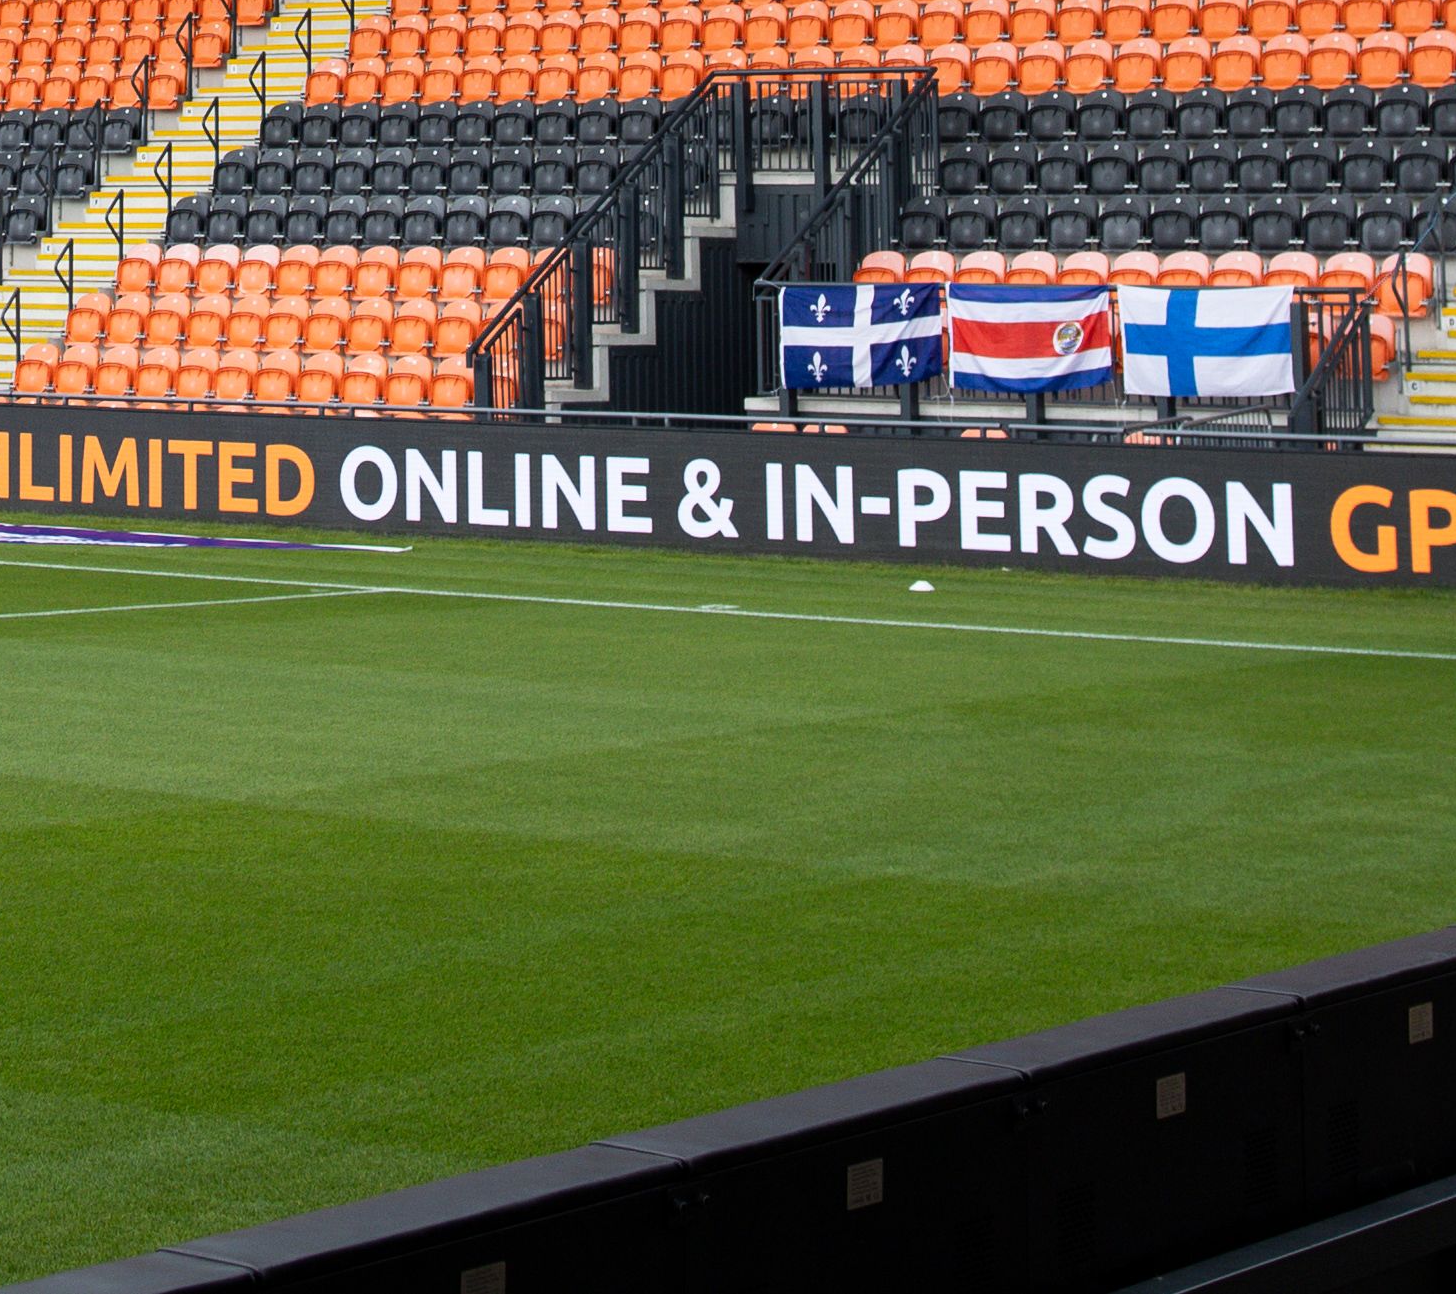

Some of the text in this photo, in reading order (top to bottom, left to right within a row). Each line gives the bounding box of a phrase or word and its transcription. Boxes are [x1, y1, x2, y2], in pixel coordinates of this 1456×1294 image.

[340, 445, 654, 533] ONLINE
[677, 458, 739, 538] &
[766, 463, 1294, 567] IN-PERSON
